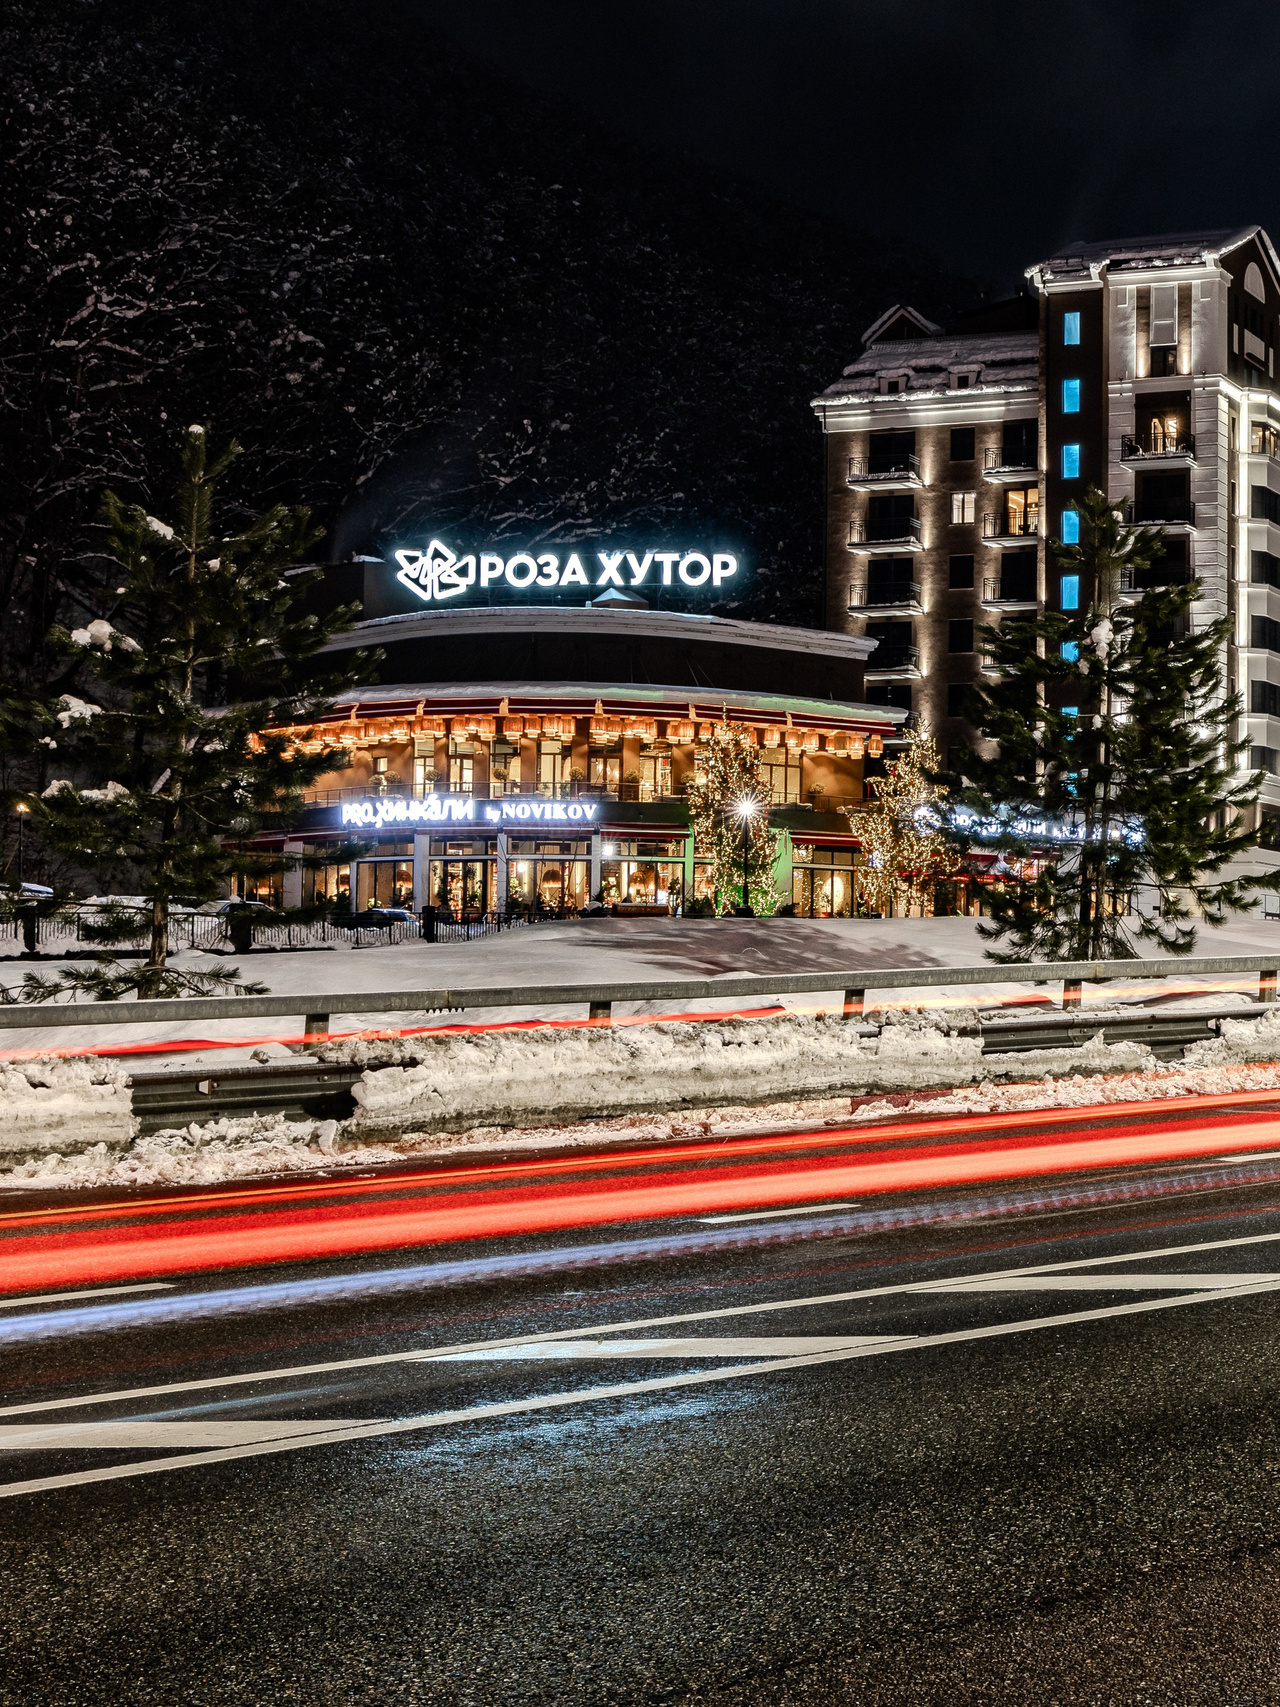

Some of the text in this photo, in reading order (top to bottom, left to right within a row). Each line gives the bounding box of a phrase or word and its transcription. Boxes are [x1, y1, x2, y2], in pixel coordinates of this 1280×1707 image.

[480, 552, 738, 587] РОЗА ХУТОР
[502, 803, 598, 821] NOVIKOV
